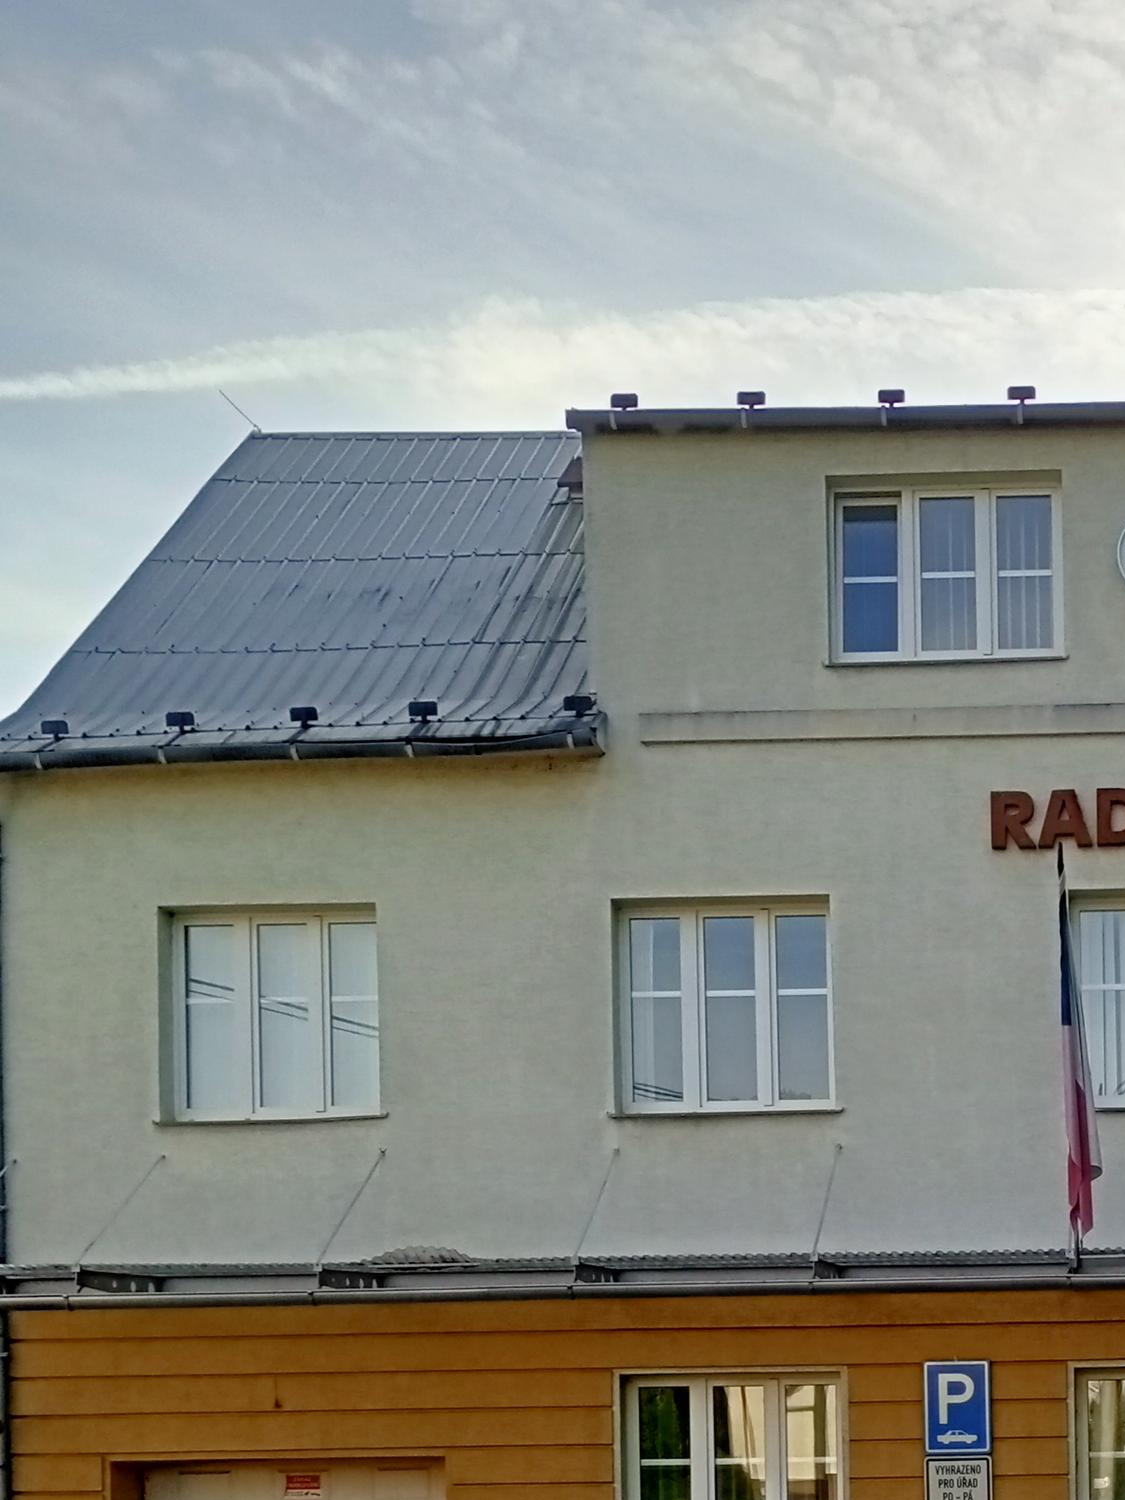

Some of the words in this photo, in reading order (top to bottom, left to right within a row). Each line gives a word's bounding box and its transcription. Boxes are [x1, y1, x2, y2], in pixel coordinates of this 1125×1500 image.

[938, 1372, 976, 1425] P
[935, 1464, 982, 1475] VYHRAZENO
[938, 1478, 954, 1489] PRO
[956, 1477, 979, 1489] ÚŘAD
